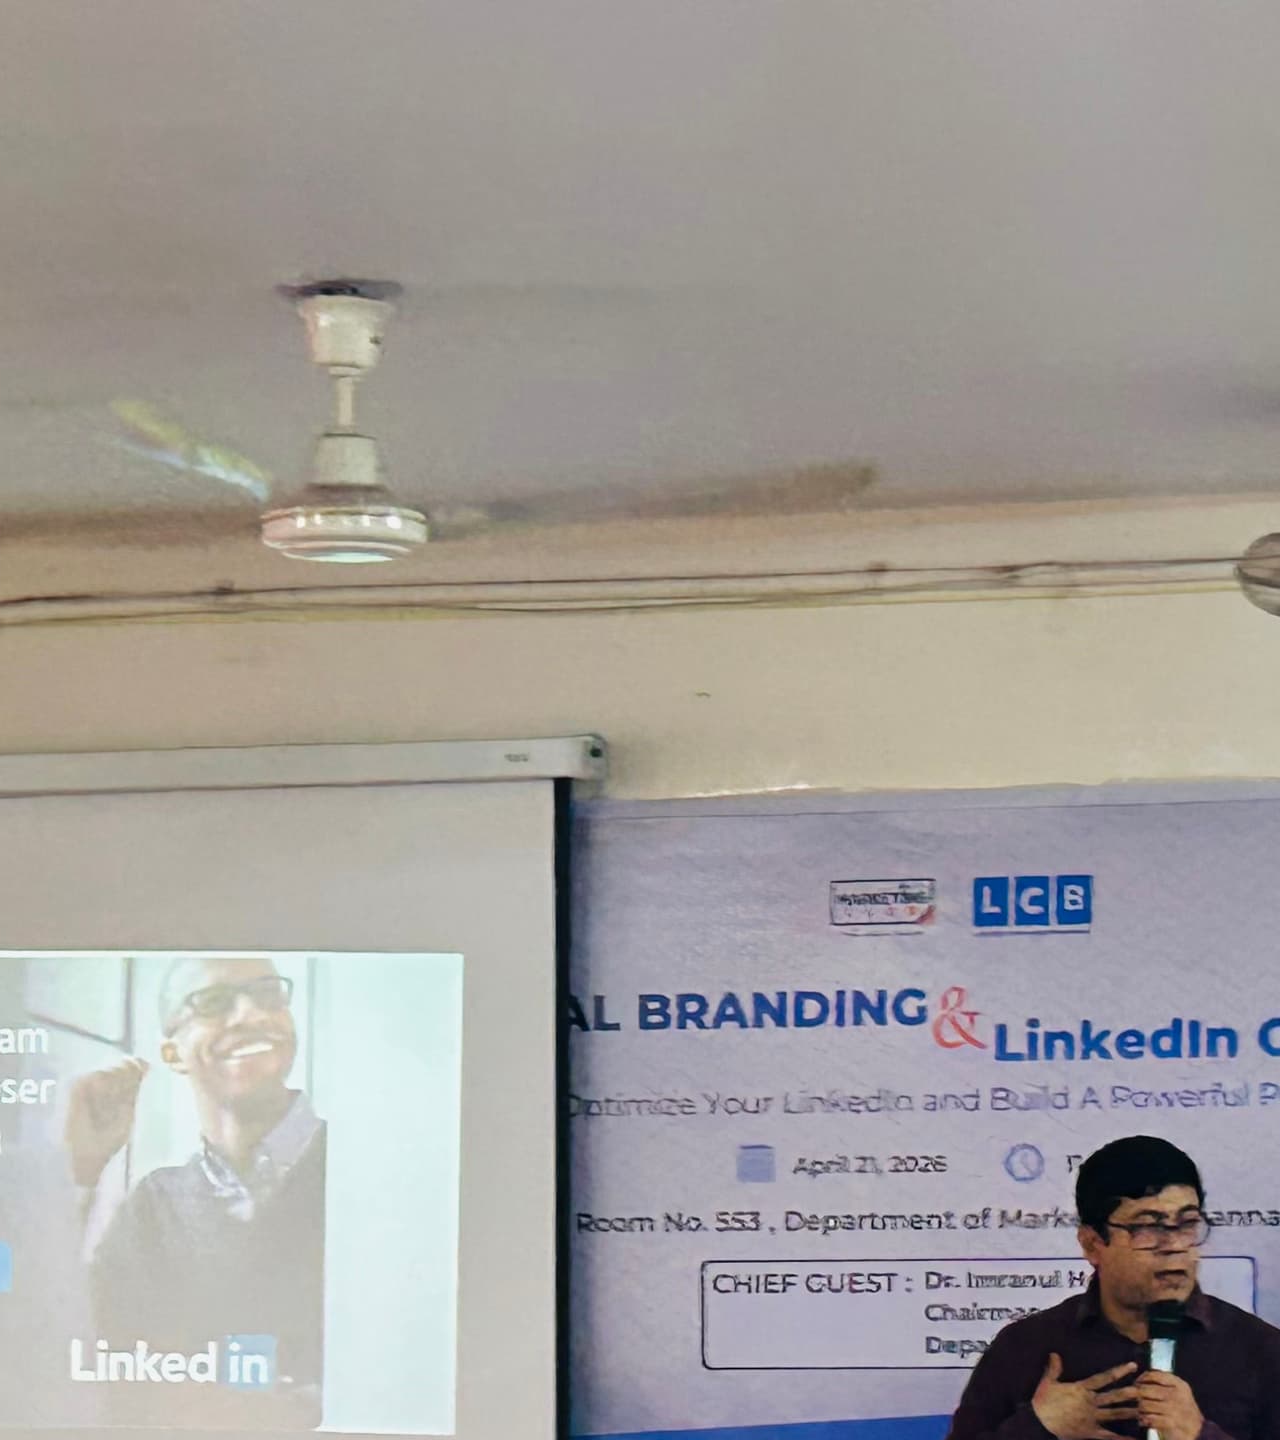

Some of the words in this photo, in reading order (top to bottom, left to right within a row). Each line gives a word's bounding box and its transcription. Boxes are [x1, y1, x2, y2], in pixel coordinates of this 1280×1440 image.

[979, 882, 1088, 917] LCB
[568, 994, 621, 1032] AL
[638, 988, 928, 1031] BRANDING
[931, 986, 989, 1050] &
[994, 1017, 1238, 1062] LinkedIn
[708, 1091, 775, 1116] Your
[922, 1087, 981, 1112] and
[990, 1085, 1070, 1112] Build
[1078, 1087, 1103, 1111] A
[1111, 1082, 1250, 1108] Powerful
[576, 1211, 656, 1232] Room
[784, 1209, 957, 1236] Department
[963, 1207, 993, 1229] of
[712, 1273, 799, 1295] CHIEF
